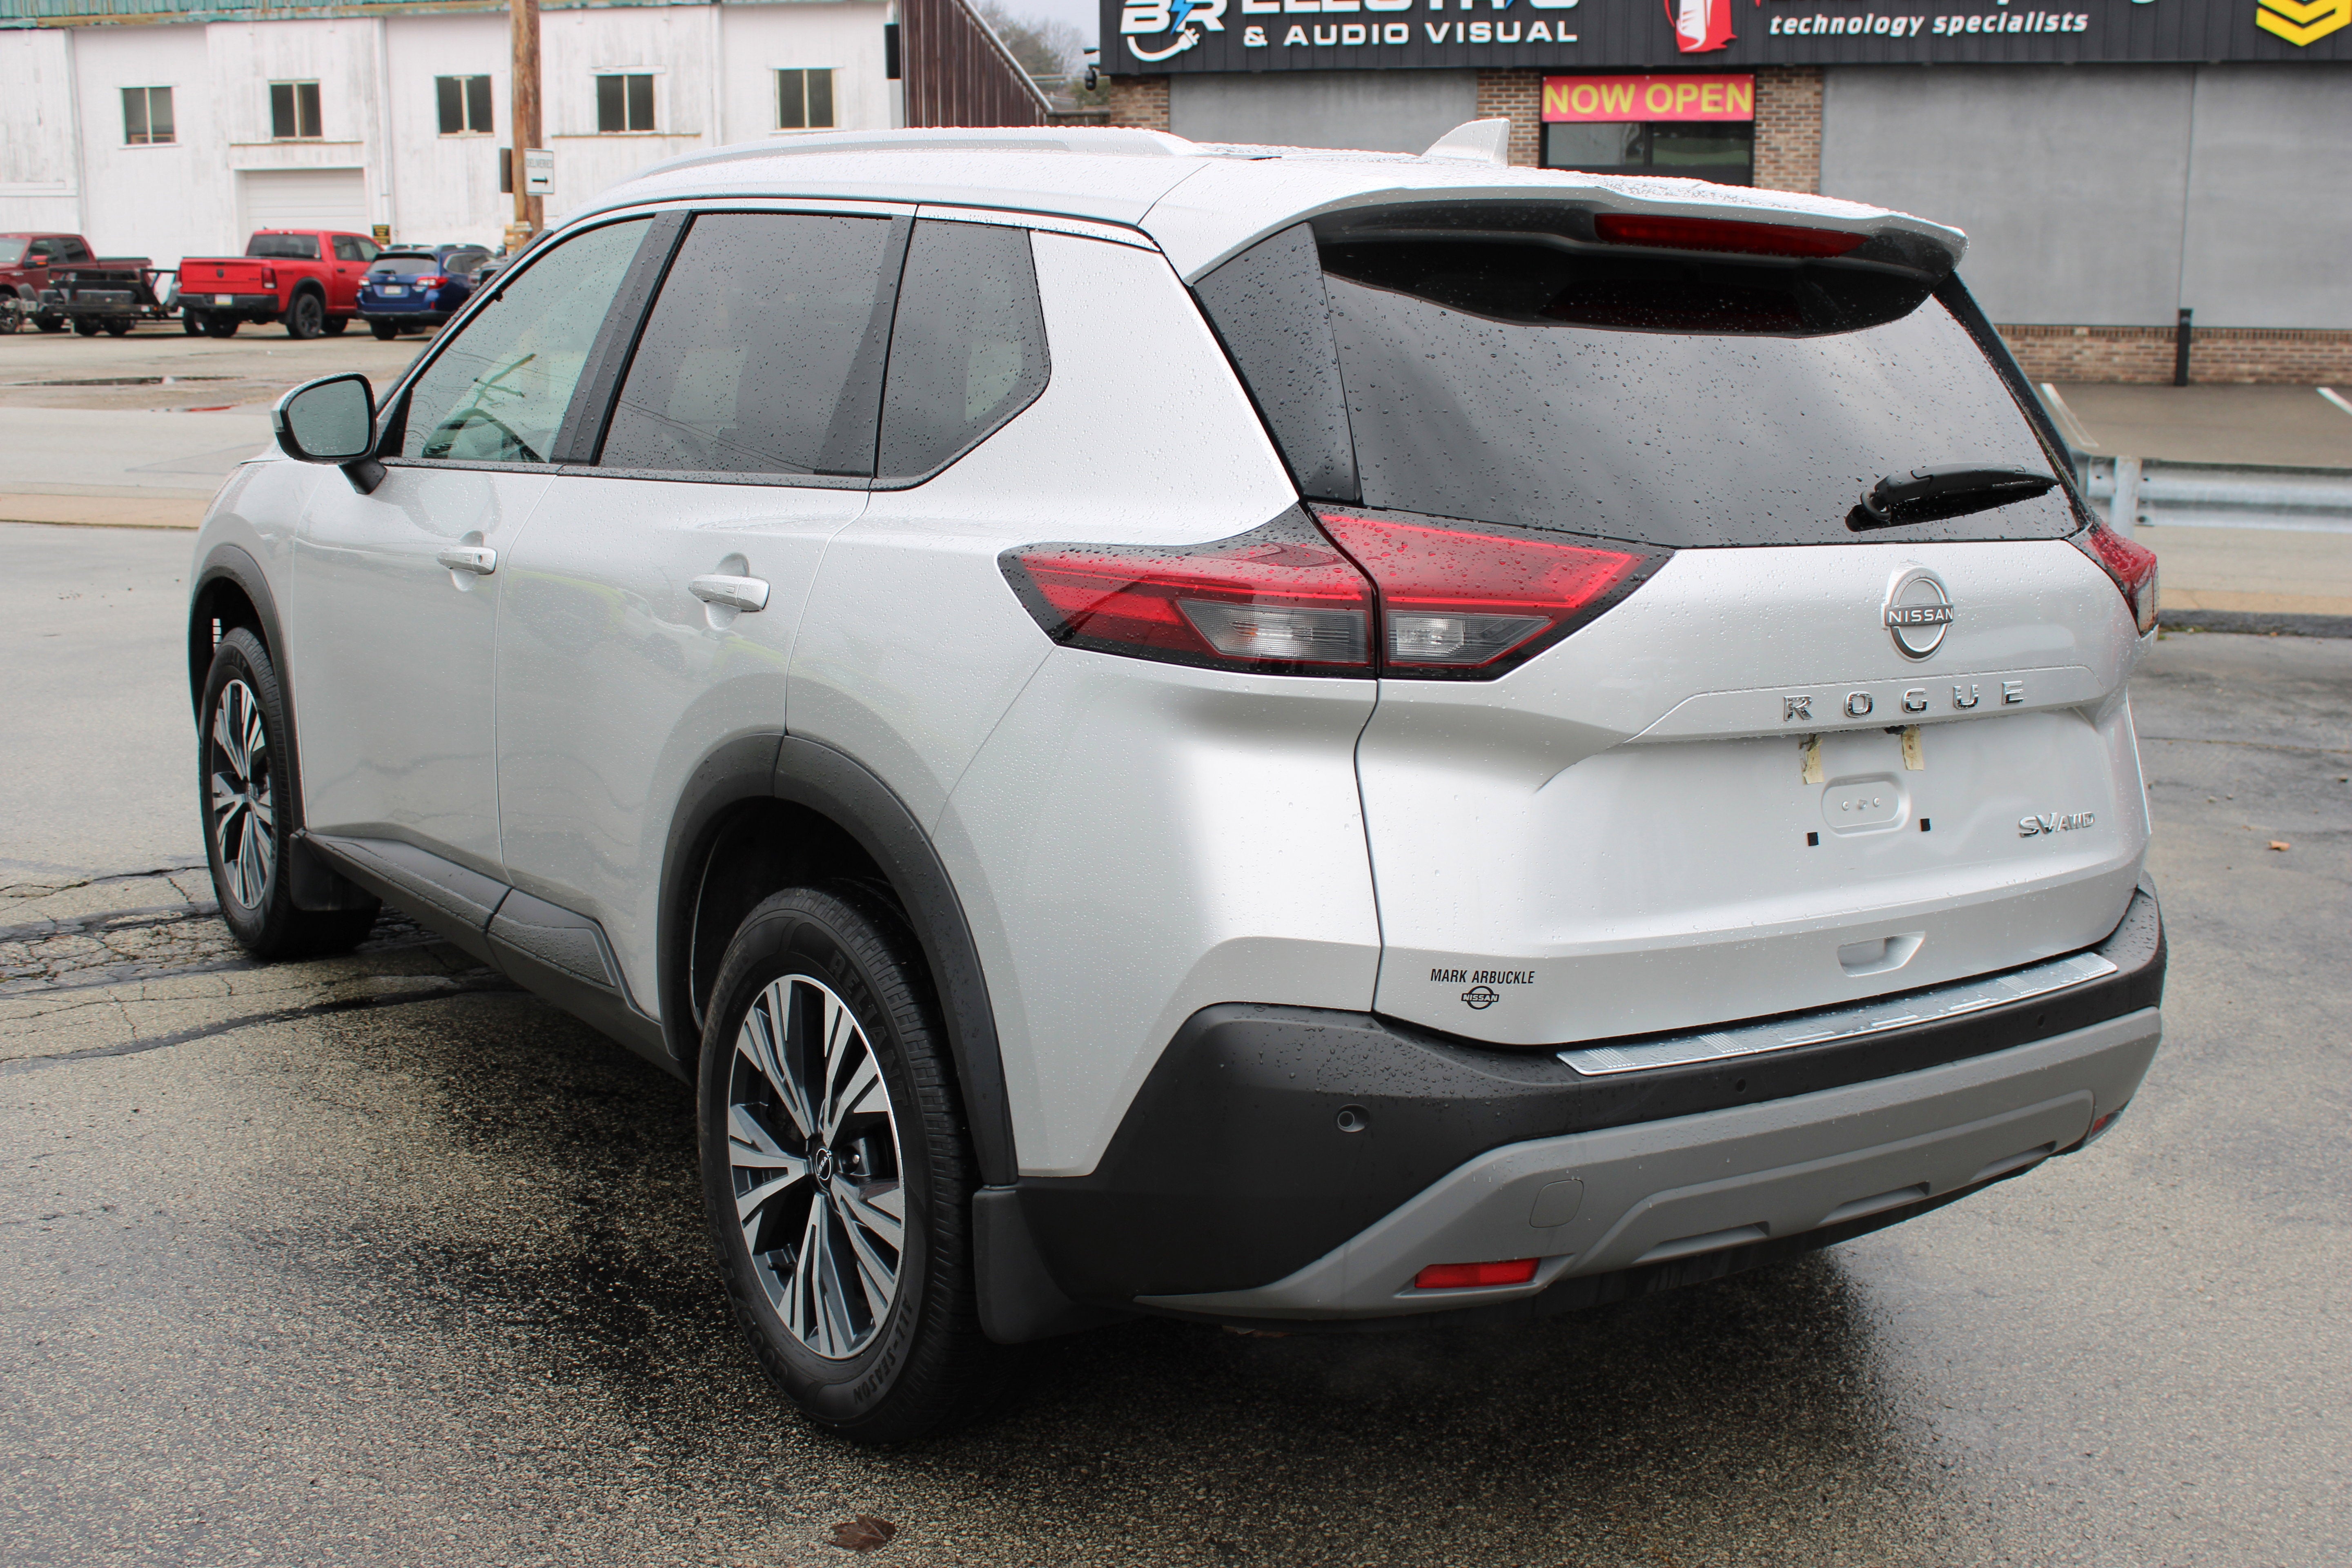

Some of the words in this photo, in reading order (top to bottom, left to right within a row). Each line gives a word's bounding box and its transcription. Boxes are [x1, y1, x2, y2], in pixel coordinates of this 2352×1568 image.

[1244, 25, 1268, 47] &
[1283, 22, 1409, 46] AUDIO
[1424, 20, 1578, 44] VISUAL
[1770, 13, 1925, 37] technology
[1932, 12, 2089, 36] specialists
[1544, 84, 1635, 114] NOW
[1645, 82, 1752, 113] OPEN
[1888, 608, 1953, 623] NISSAN
[1783, 680, 2024, 722] ROGUE
[2018, 812, 2057, 837] SV
[1430, 969, 1468, 983] MARK
[1471, 970, 1535, 984] ARBUCKLE
[828, 949, 909, 1106] RELIANT
[853, 1293, 913, 1405] ALL-SEASON
